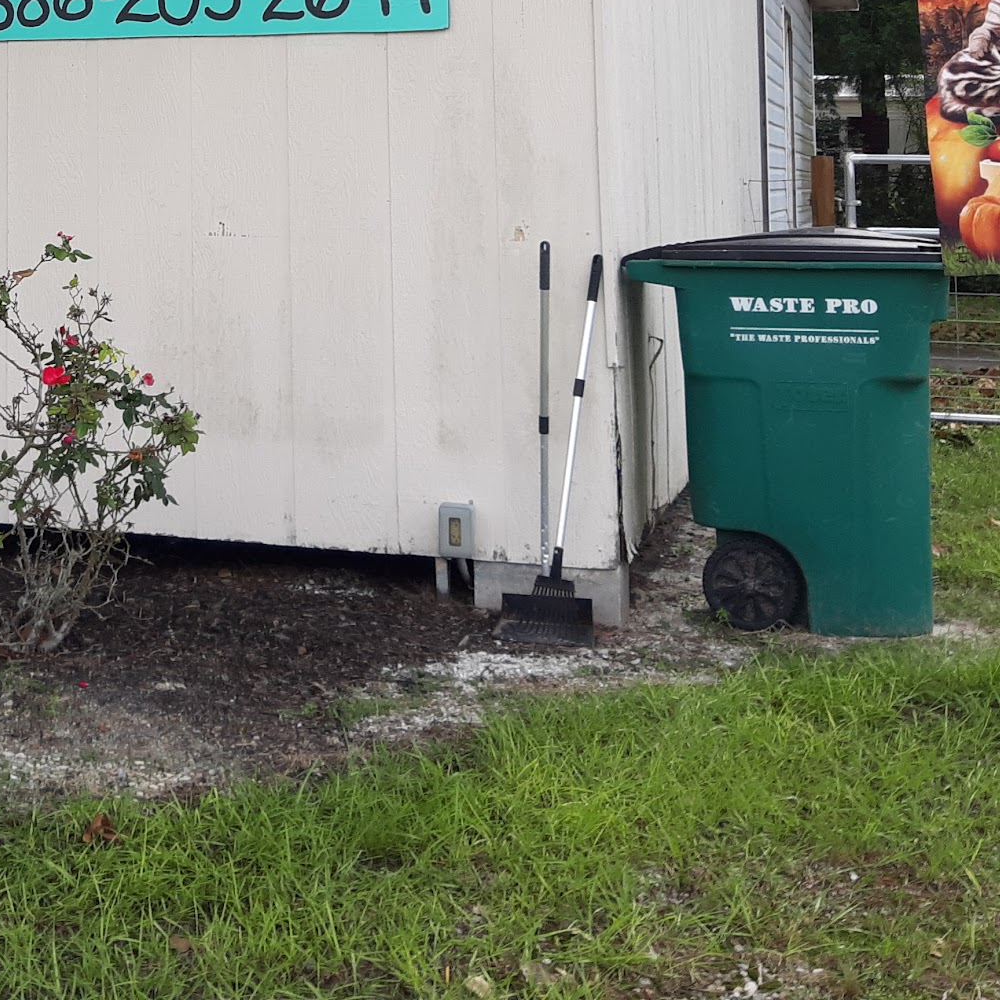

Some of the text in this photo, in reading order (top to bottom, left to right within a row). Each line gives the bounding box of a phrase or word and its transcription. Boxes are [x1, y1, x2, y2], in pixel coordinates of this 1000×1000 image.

[729, 296, 878, 315] WASTE PRO
[758, 334, 791, 342] WASTE
